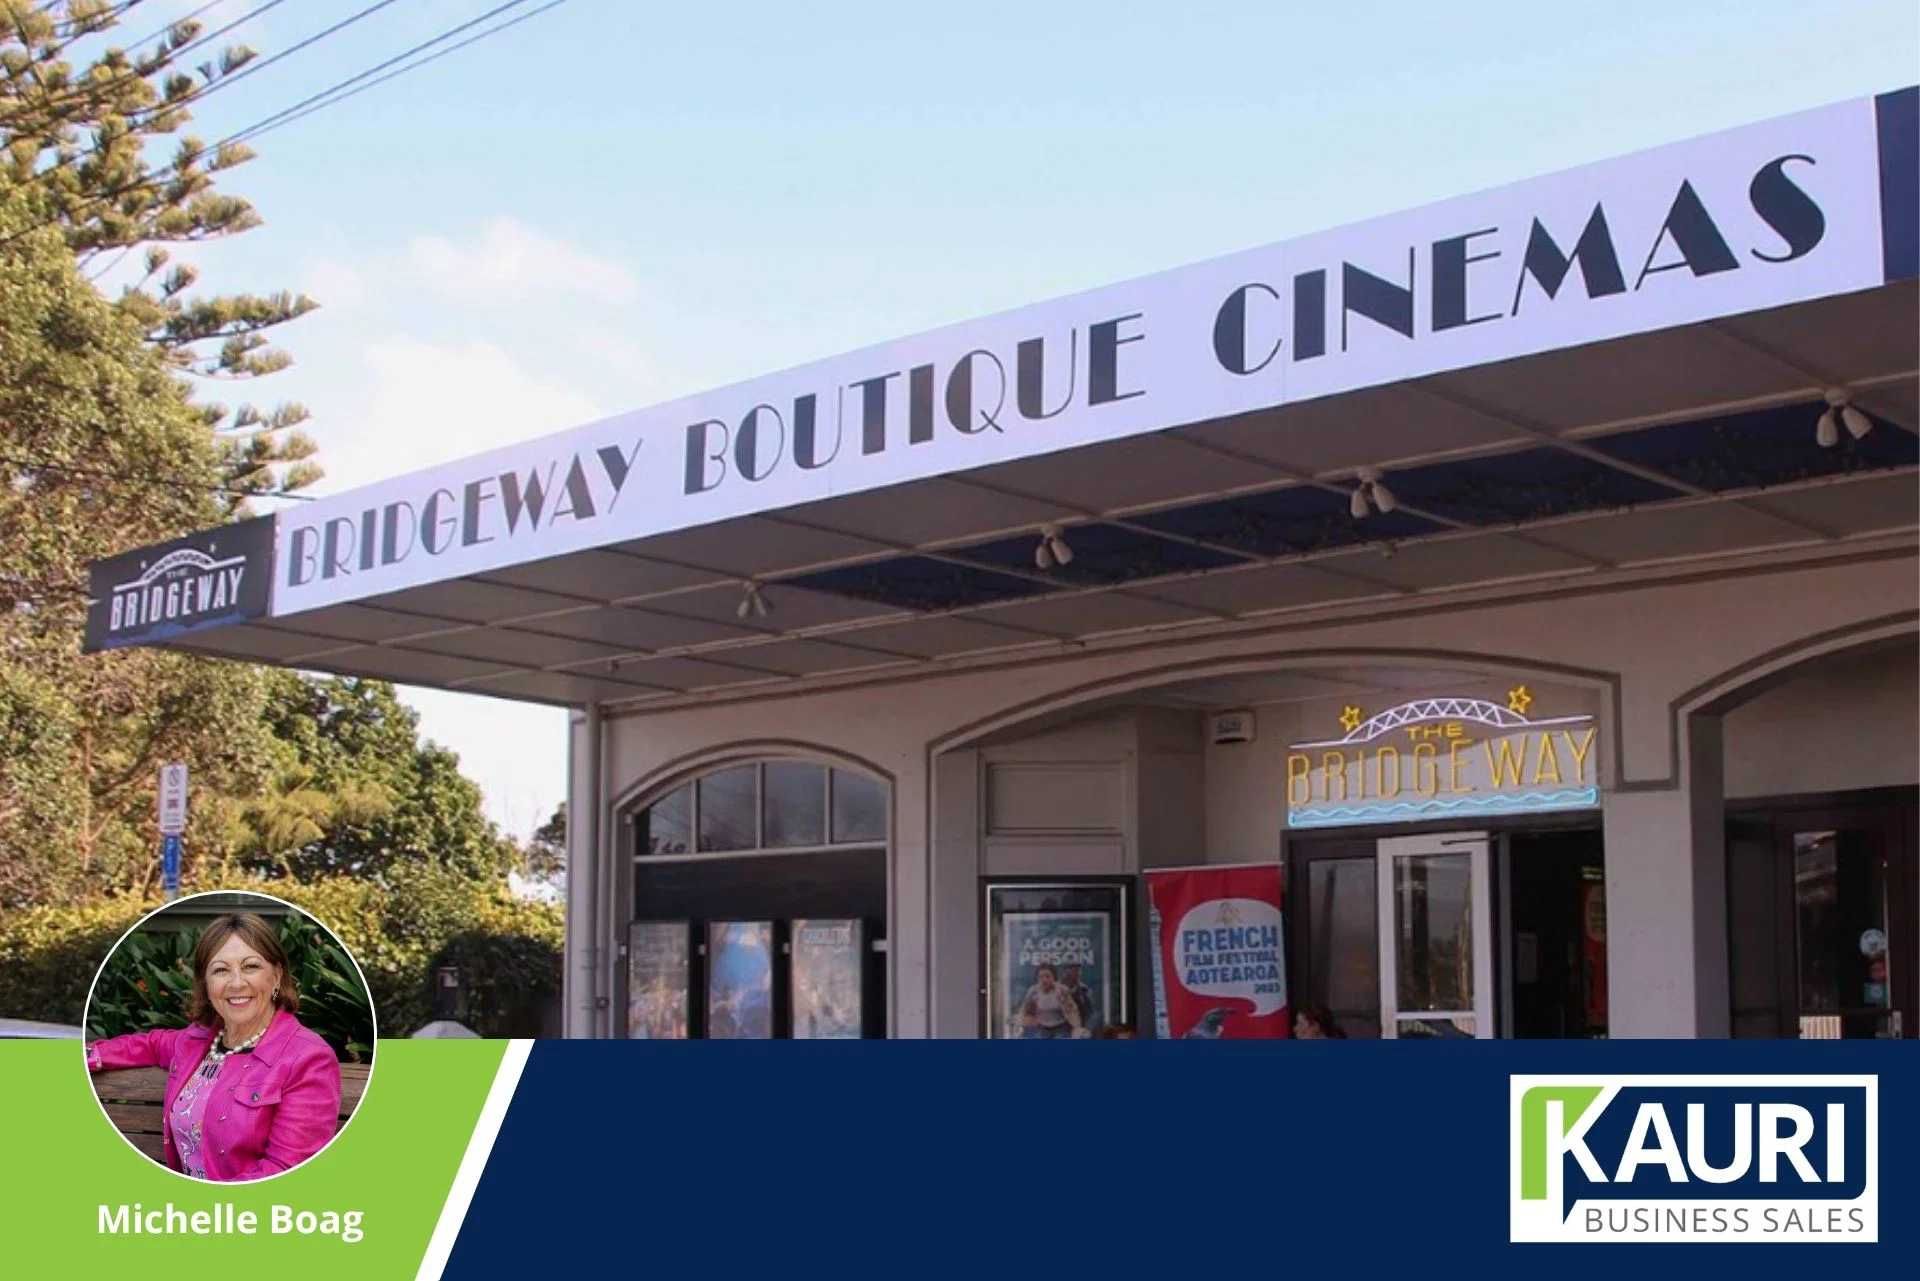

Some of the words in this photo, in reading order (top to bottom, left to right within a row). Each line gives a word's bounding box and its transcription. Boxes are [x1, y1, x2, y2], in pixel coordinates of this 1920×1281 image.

[287, 437, 645, 588] BRIDGEWAY
[684, 312, 1147, 496] BOUTIQUE
[1212, 153, 1827, 376] CINEMAS
[110, 566, 245, 631] BRIDGEWAY
[1405, 722, 1466, 741] THE
[1287, 726, 1597, 808] BRIDGEWAY
[1023, 937, 1035, 951] A
[1040, 937, 1091, 951] GOOD
[1182, 925, 1279, 953] FRENCH
[1019, 949, 1095, 967] PERSON
[1184, 953, 1215, 969] FILM
[1217, 949, 1280, 966] FESTIVAL
[1186, 963, 1279, 986] AOTEAROA
